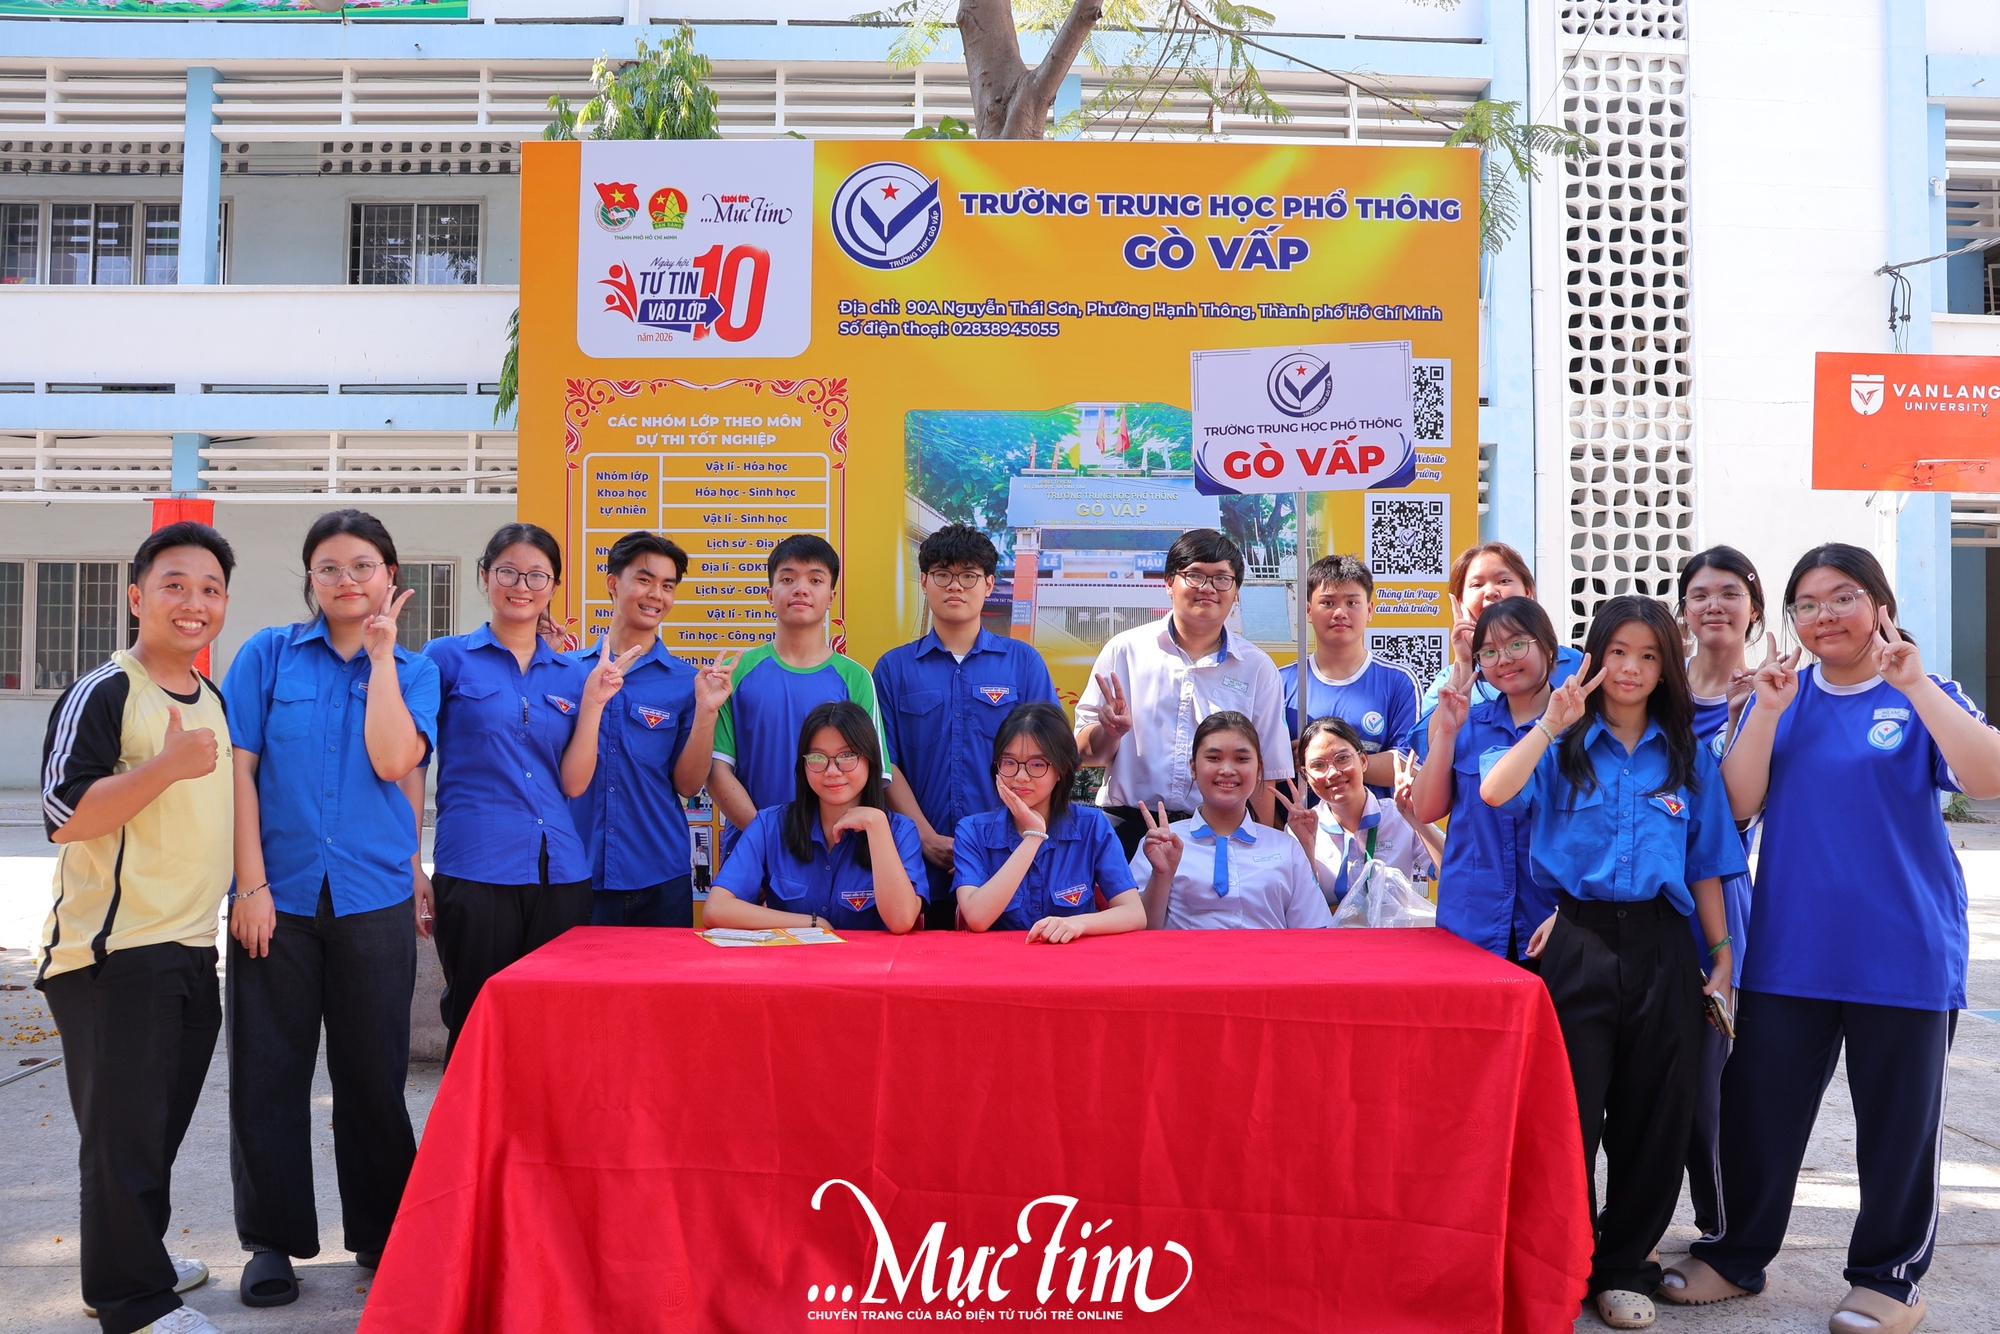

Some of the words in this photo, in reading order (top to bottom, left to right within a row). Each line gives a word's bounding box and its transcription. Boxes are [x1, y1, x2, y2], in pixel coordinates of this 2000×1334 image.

[959, 187, 1090, 216] TRƯỜNG
[1095, 193, 1202, 218] TRUNG
[1208, 194, 1276, 224] HỌC
[1282, 188, 1349, 220] PHỔ
[1354, 192, 1462, 222] THÔNG
[930, 210, 939, 225] VẤP
[928, 225, 937, 237] GÒ
[916, 237, 931, 254] THPT
[1123, 225, 1196, 270] GÒ
[1205, 224, 1310, 271] VẤP
[650, 257, 675, 269] Ngày
[676, 258, 690, 268] hội
[889, 252, 918, 268] TRƯỜNG
[639, 271, 666, 297] TỰ
[669, 271, 699, 295] TIN
[692, 244, 771, 342] 10
[648, 301, 676, 321] VÀO
[678, 301, 707, 321] LỚP
[839, 299, 867, 317] Địa
[870, 299, 900, 316] chỉ:
[905, 301, 941, 315] 90A
[943, 299, 1006, 318] Nguyễn
[1009, 300, 1045, 316] Thái
[1047, 301, 1084, 318] Sơn,
[1086, 300, 1150, 319] Phường
[1153, 302, 1197, 320] Hạnh
[1199, 302, 1257, 321] Thông,
[1258, 302, 1310, 319] Thành
[1312, 302, 1347, 322] phố
[1347, 302, 1372, 320] Hồ
[1372, 303, 1402, 320] Chí
[1402, 305, 1443, 321] Minh
[838, 318, 863, 336] Số
[863, 320, 900, 338] điện
[902, 321, 950, 339] thoại:
[951, 321, 1060, 338] 02838945055
[637, 333, 653, 342] năm
[655, 333, 673, 342] 2026
[1892, 383, 2000, 399] VANLANG
[1904, 402, 1989, 412] UNIVERSITY
[607, 413, 638, 428] CÁC
[641, 414, 686, 427] NHÓM
[690, 414, 719, 427] LỚP
[723, 416, 763, 427] THEO
[767, 413, 802, 427] MÔN
[1204, 423, 1255, 436] TRƯỜNG
[1257, 422, 1298, 434] TRUNG
[1301, 421, 1327, 433] HỌC
[1330, 417, 1357, 431] PHỔ
[1359, 416, 1403, 429] THÔNG
[636, 432, 659, 448] DỰ
[661, 434, 685, 445] THI
[689, 430, 718, 445] TỐT
[721, 431, 776, 448] NGHIỆP
[1223, 441, 1285, 480] GÒ
[1295, 435, 1385, 476] VẤP
[705, 460, 724, 474] Vật
[727, 460, 735, 471] lí
[743, 461, 765, 471] Hóa
[768, 462, 788, 474] học
[596, 470, 628, 481] Nhóm
[630, 470, 649, 483] lớp
[1416, 469, 1440, 480] rường
[597, 488, 625, 497] Khoa
[627, 488, 647, 499] học
[695, 487, 717, 497] Hóa
[719, 488, 739, 499] học
[749, 487, 773, 497] Sinh
[776, 488, 796, 499] học
[1084, 491, 1111, 500] TRUNG
[1113, 492, 1130, 501] HỌC
[1150, 491, 1179, 500] THÔNG
[600, 505, 614, 517] tự
[615, 505, 647, 515] nhiên
[1076, 500, 1105, 517] GÒ
[1109, 499, 1148, 517] VẤP
[703, 513, 722, 526] Vật
[724, 513, 732, 523] lí
[741, 514, 765, 523] Sinh
[768, 514, 788, 526] học
[706, 539, 729, 551] Lịch
[732, 538, 747, 548] sử
[756, 539, 774, 550] Địa
[595, 547, 610, 556] Nh
[596, 564, 609, 572] Kh
[701, 563, 719, 574] Địa
[722, 562, 729, 572] lí
[738, 563, 768, 572] GDKT
[1137, 555, 1163, 570] HẬU
[695, 585, 718, 597] Lịch
[721, 584, 735, 595] sử
[744, 586, 768, 595] GDK
[1377, 589, 1402, 600] Thông
[1404, 589, 1415, 598] tin
[1417, 589, 1438, 600] Page
[707, 608, 726, 621] Vật
[728, 608, 736, 618] lí
[744, 610, 762, 618] Tin
[764, 610, 778, 621] họ
[1376, 602, 1391, 612] của
[1393, 603, 1409, 612] nhà
[1410, 603, 1438, 615] trường
[679, 631, 696, 640] Tin
[698, 631, 718, 643] học
[727, 631, 756, 642] Công
[758, 631, 776, 642] ngh
[701, 657, 715, 667] họ
